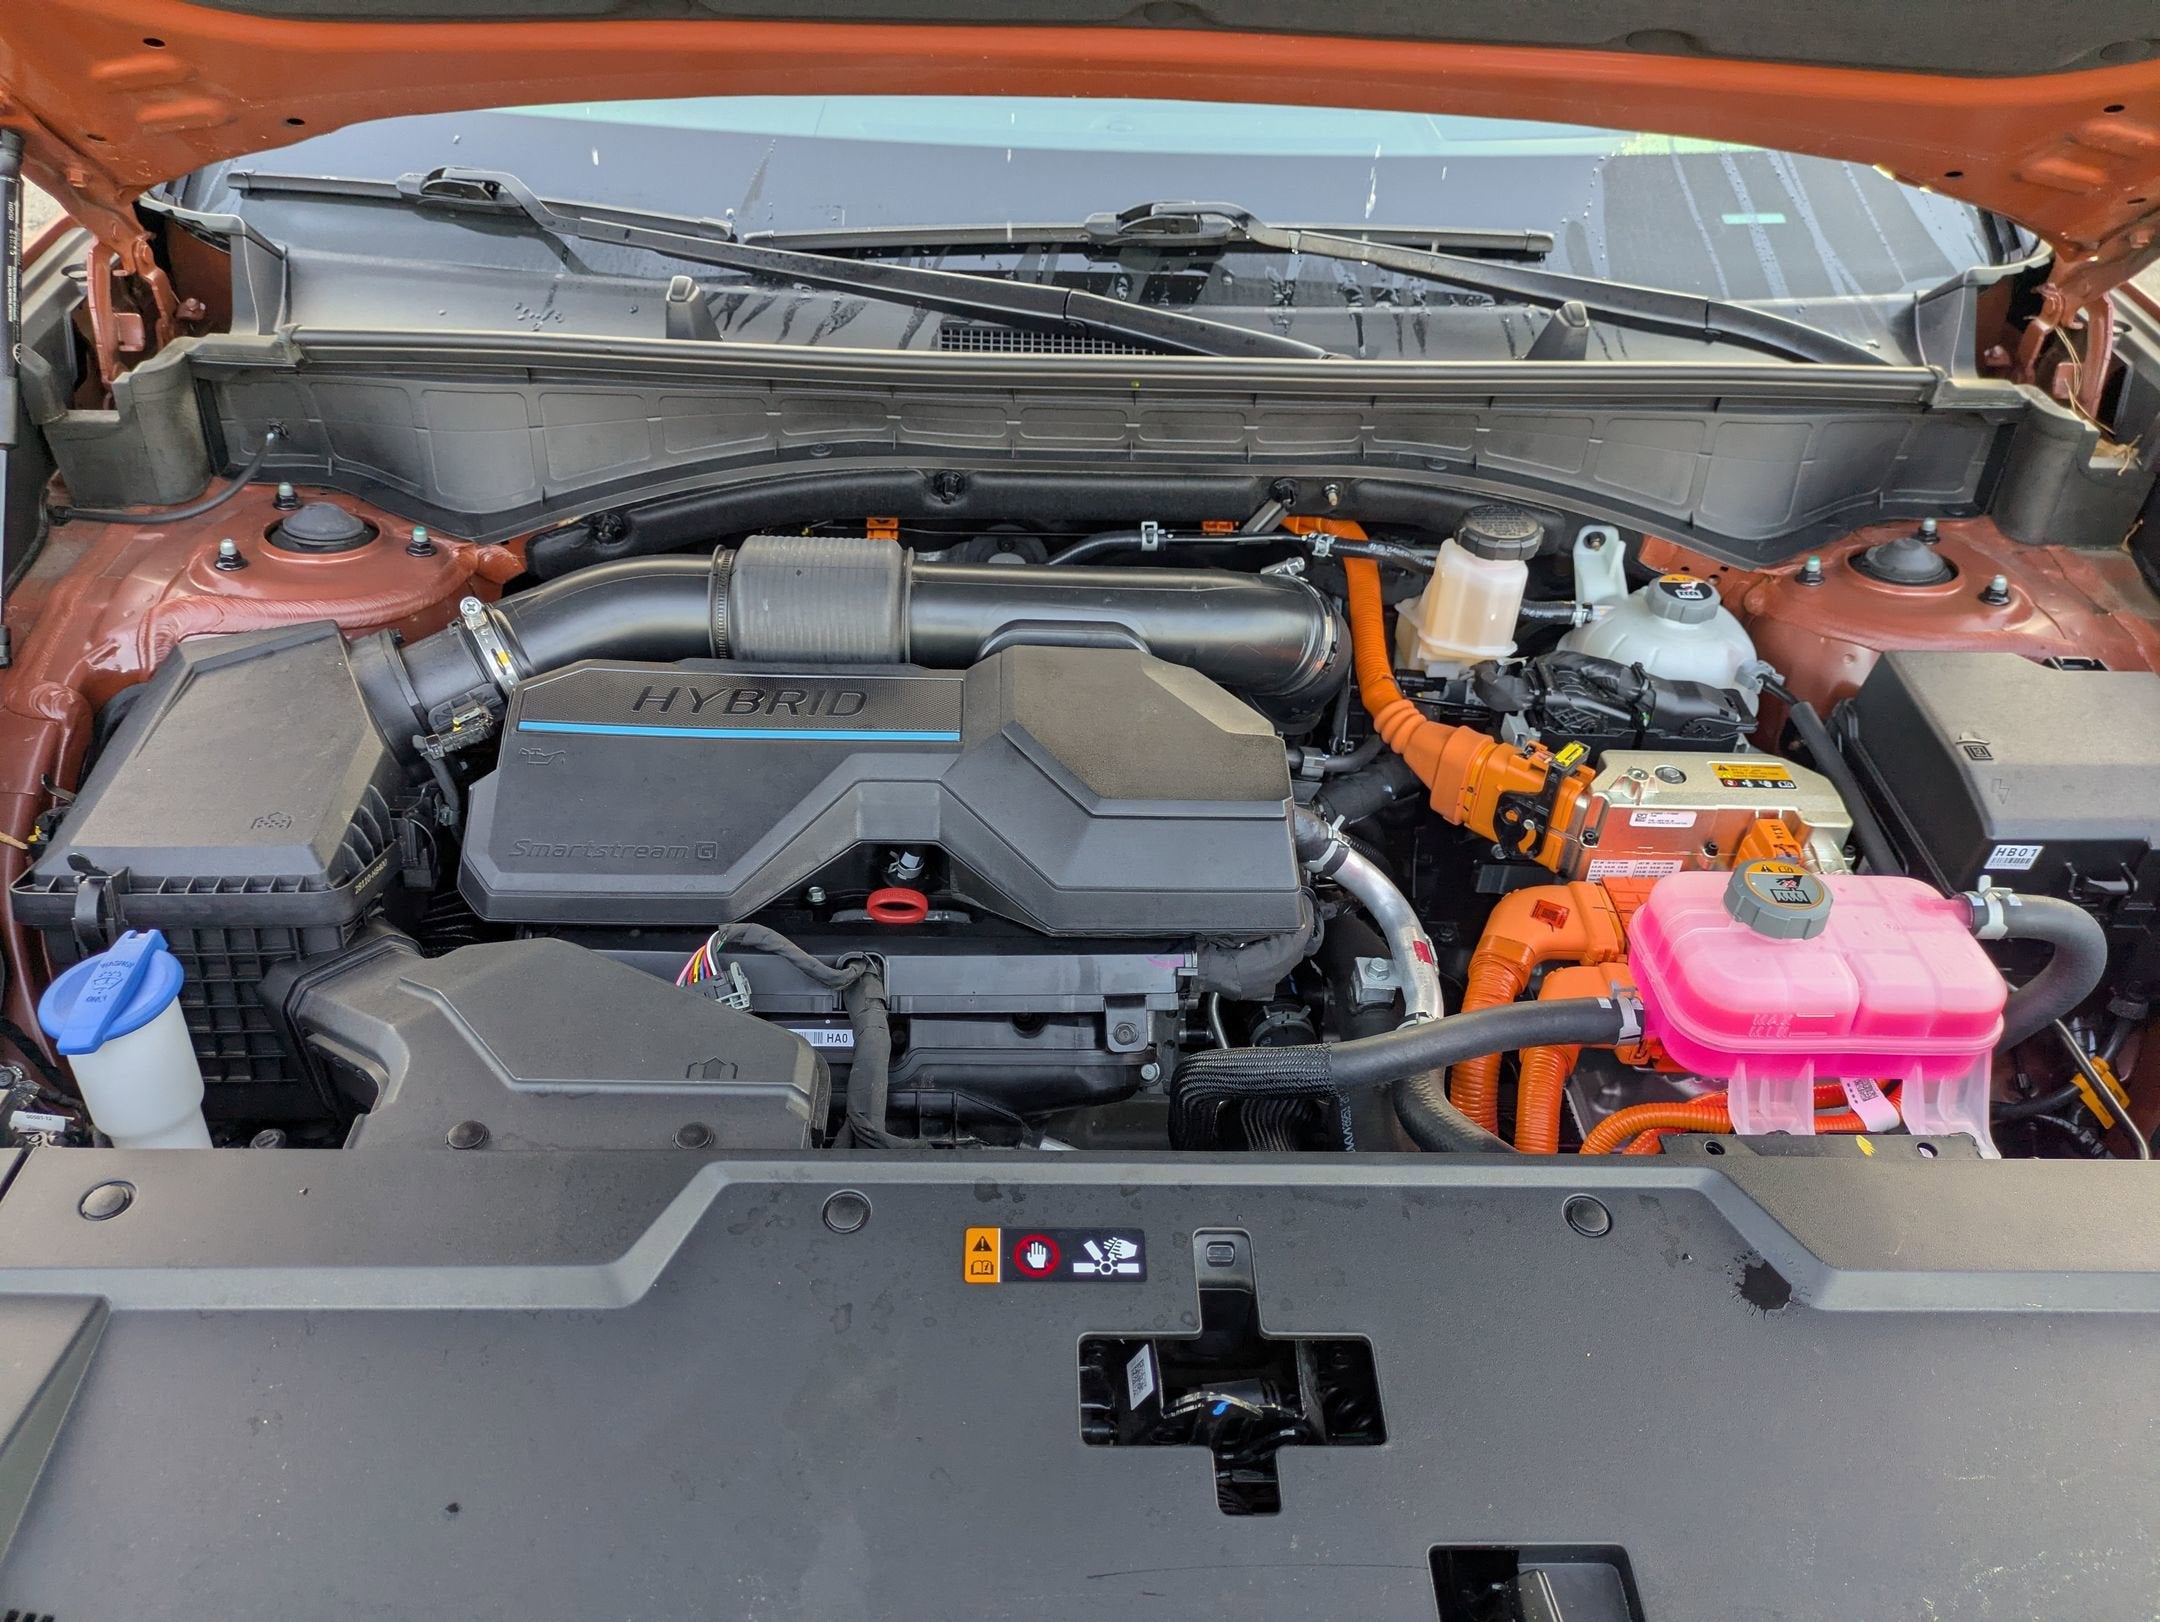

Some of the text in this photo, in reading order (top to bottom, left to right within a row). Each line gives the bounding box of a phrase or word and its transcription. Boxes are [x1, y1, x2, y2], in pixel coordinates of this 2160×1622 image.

[631, 685, 868, 718] HYBRID
[508, 838, 689, 859] Smartstream
[1995, 847, 2038, 857] HB01
[1752, 1013, 1792, 1026] MAX
[1747, 1026, 1791, 1038] MIN
